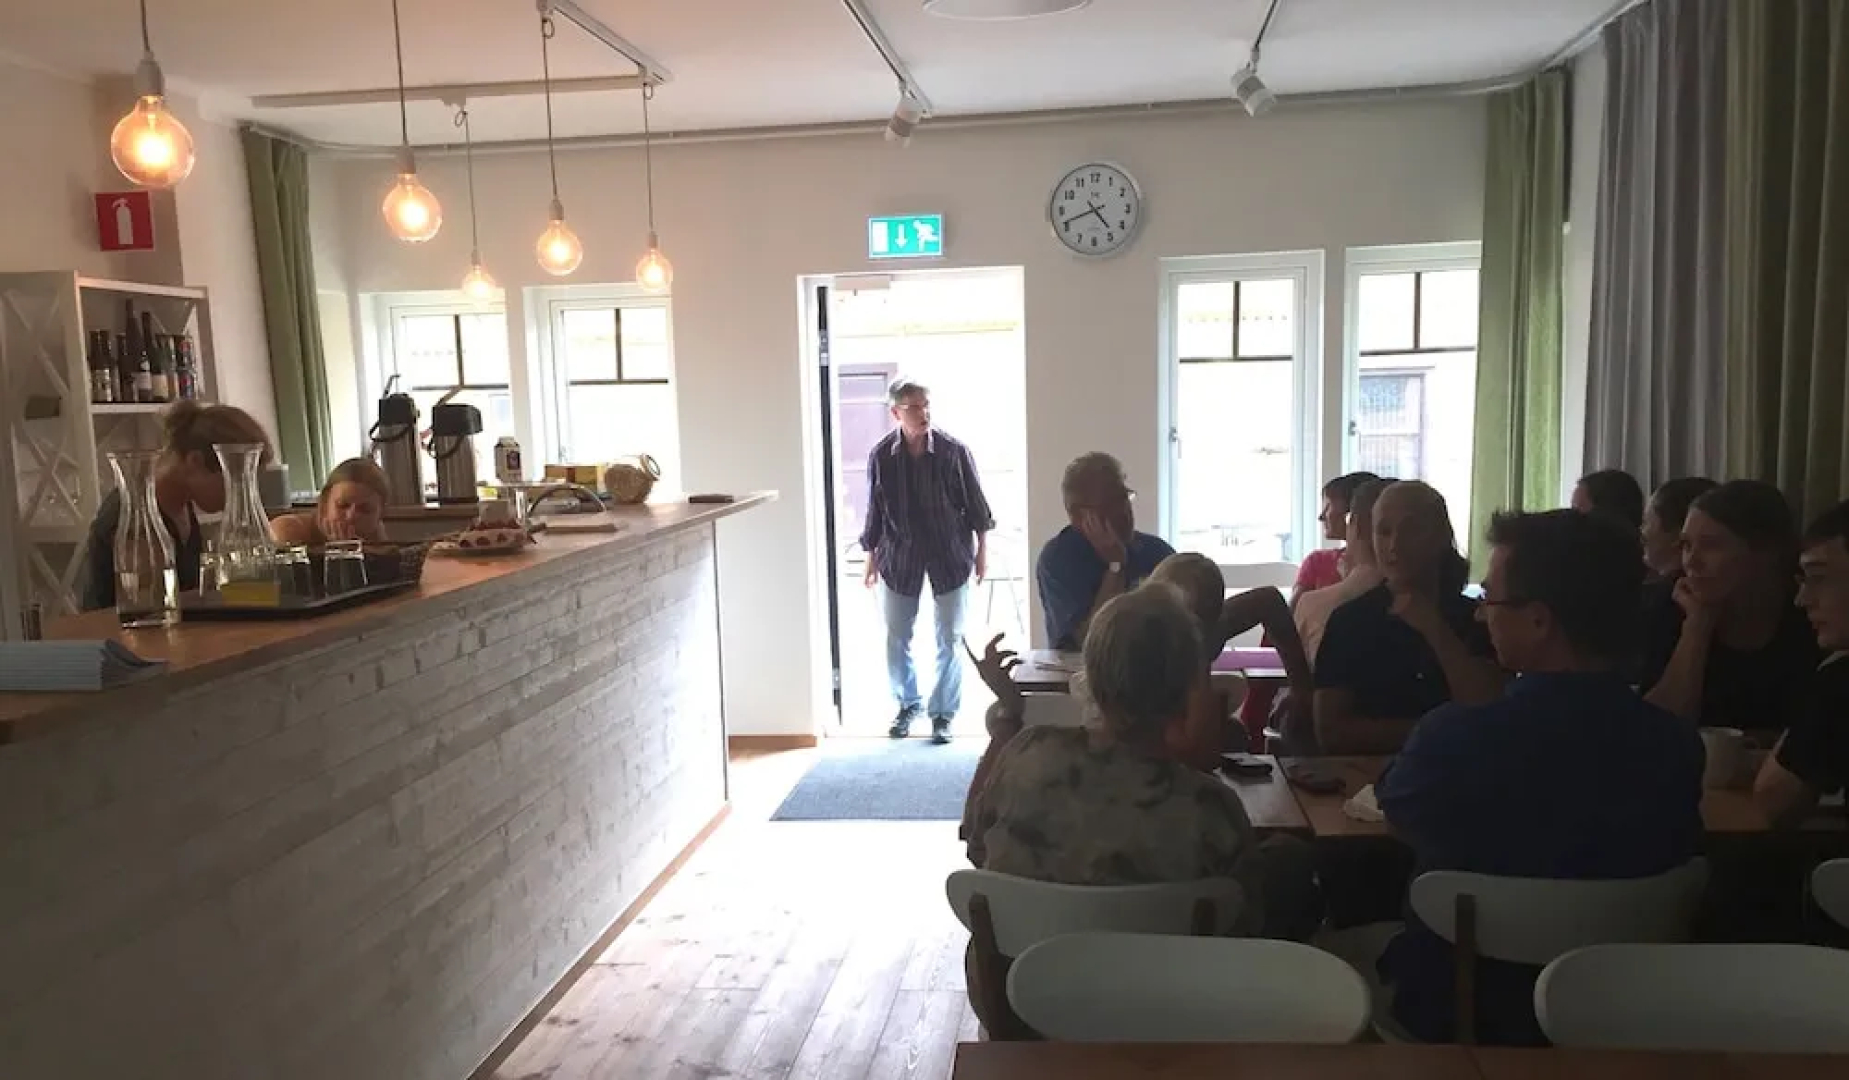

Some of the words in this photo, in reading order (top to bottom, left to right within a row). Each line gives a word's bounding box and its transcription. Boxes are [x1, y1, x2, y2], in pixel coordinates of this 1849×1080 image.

[1075, 177, 1085, 188] 11
[1090, 172, 1101, 184] 12
[1108, 176, 1113, 187] 1
[1064, 189, 1075, 201] 10
[1120, 187, 1126, 198] 2
[1124, 203, 1131, 215] 3
[1119, 220, 1125, 230] 4
[1077, 233, 1083, 244] 7
[1107, 232, 1114, 242] 5
